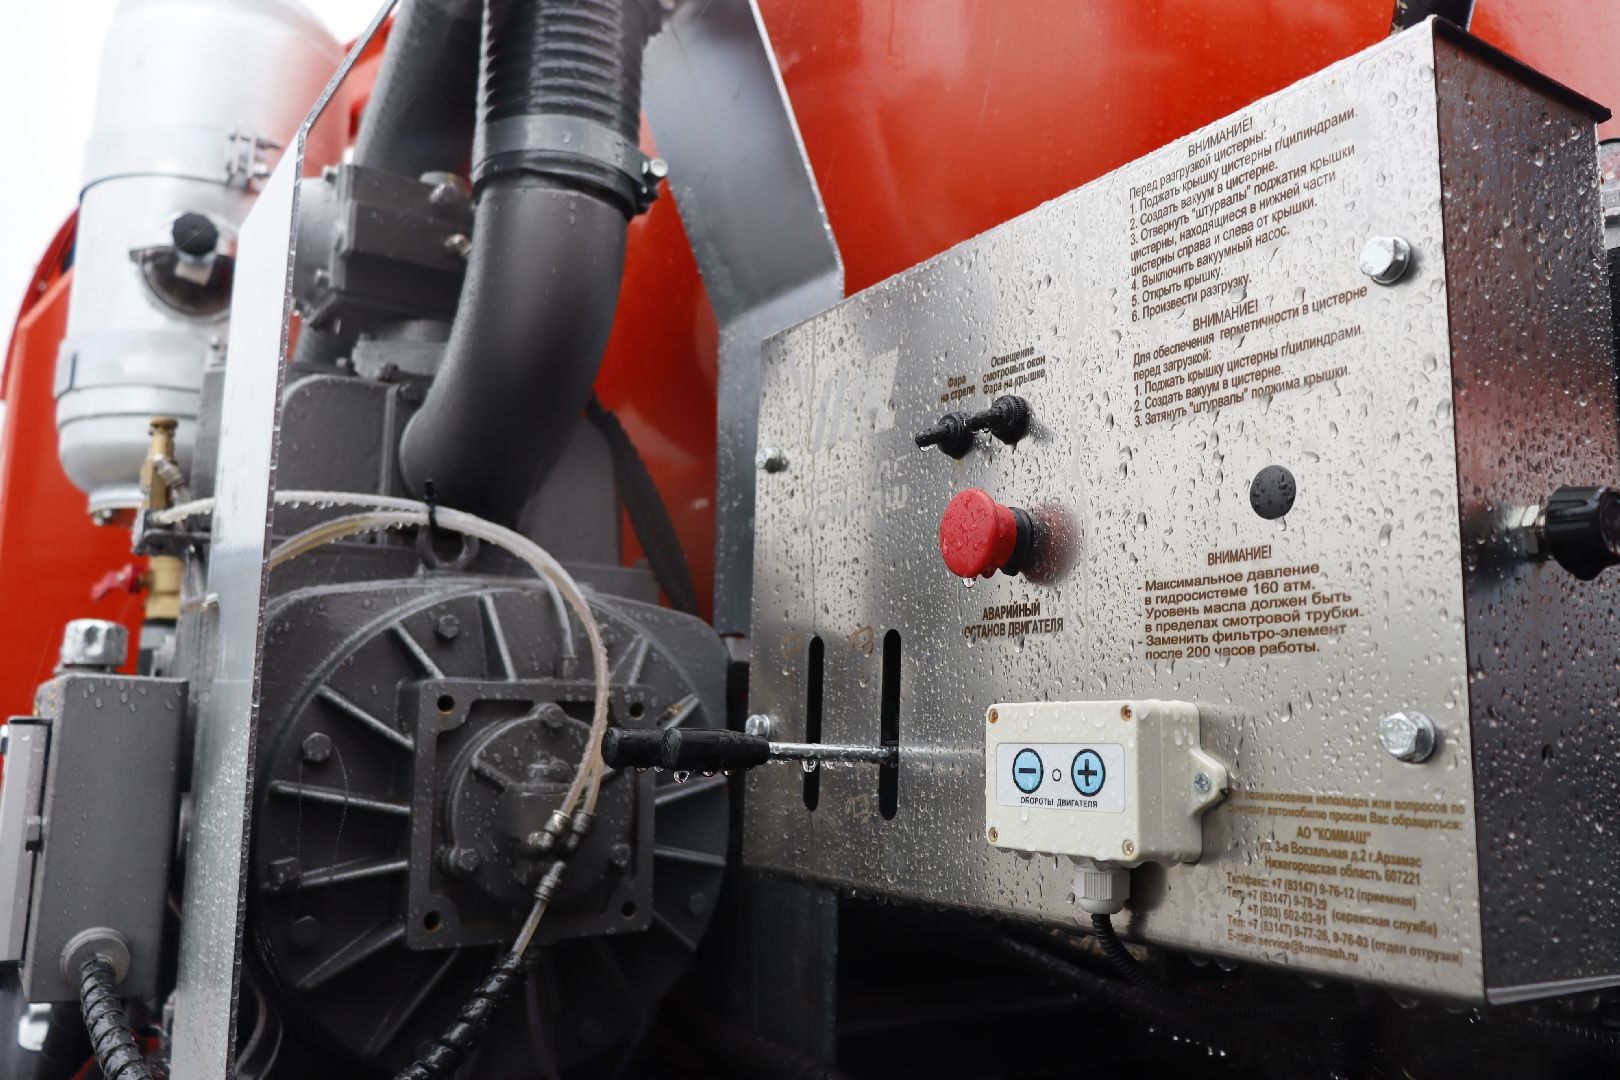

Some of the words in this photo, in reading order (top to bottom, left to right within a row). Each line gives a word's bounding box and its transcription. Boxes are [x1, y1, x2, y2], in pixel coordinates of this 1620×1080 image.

[1188, 116, 1253, 158] ВНИМАНИЕ!
[1129, 179, 1158, 200] Перед
[1160, 153, 1211, 189] разгрузкой
[1214, 130, 1267, 163] цистерны:
[1130, 202, 1138, 215] 1.
[1140, 185, 1180, 210] Поджать
[1182, 168, 1219, 193] крышку
[1221, 143, 1272, 176] цистерны
[1274, 107, 1358, 152] г/цилиндрами.
[1130, 218, 1138, 230] 2.
[1140, 203, 1179, 225] Создать
[1181, 187, 1215, 210] вакуум
[1217, 183, 1224, 194] в
[1226, 160, 1279, 190] цистерне.
[1130, 233, 1138, 246] 3.
[1140, 215, 1190, 241] Отвернуть
[1192, 186, 1250, 219] "штурвалы"
[1254, 164, 1307, 195] поджатия
[1310, 144, 1355, 175] крышки
[1131, 236, 1177, 261] цистерны,
[1180, 206, 1247, 241] находящиеся
[1250, 202, 1256, 214] в
[1259, 182, 1300, 211] нижней
[1303, 170, 1336, 193] части
[1131, 251, 1175, 276] цистерны
[1177, 237, 1211, 258] справа
[1214, 234, 1220, 245] и
[1222, 221, 1254, 242] слева
[1256, 216, 1268, 229] от
[1271, 197, 1317, 225] крышки.
[1131, 278, 1139, 291] 4.
[1142, 261, 1194, 287] Выключить
[1197, 233, 1252, 267] вакуумный
[1255, 224, 1290, 249] насос.
[1131, 294, 1139, 307] 5.
[1142, 282, 1181, 303] Открыть
[1184, 266, 1224, 290] крышку.
[1131, 309, 1140, 322] 6.
[1142, 292, 1198, 320] Произвести
[1200, 273, 1252, 302] разгрузку.
[1133, 351, 1151, 368] Для
[1153, 332, 1215, 360] обеспечения
[1220, 306, 1299, 340] герметичности
[1302, 303, 1309, 315] в
[1312, 286, 1368, 313] цистерне
[1192, 298, 1259, 332] ВНИМАНИЕ!
[982, 363, 1025, 383] смотровых
[1026, 355, 1046, 369] окон
[991, 345, 1035, 368] Освещение
[1133, 364, 1161, 381] перед
[1163, 348, 1212, 373] загрузкой:
[1134, 383, 1142, 397] 1.
[1144, 374, 1185, 395] Поджать
[1187, 362, 1224, 385] крышку
[1227, 348, 1278, 372] цистерны
[1281, 324, 1364, 357] г/цилиндрами.
[947, 375, 967, 388] Фара
[950, 383, 976, 401] стреле
[983, 381, 1002, 395] Фара
[1004, 378, 1013, 389] на
[1014, 368, 1046, 388] крышке
[1134, 399, 1142, 413] 2.
[1144, 392, 1184, 410] Создать
[1185, 381, 1219, 399] вакуум
[1222, 378, 1229, 390] в
[1231, 364, 1284, 388] цистерне.
[1134, 414, 1142, 428] 3.
[1144, 406, 1187, 426] Затянуть
[1189, 387, 1248, 414] "штурвалы"
[1251, 377, 1300, 399] поджима
[1303, 365, 1351, 389] крышки.
[1207, 544, 1272, 567] ВНИМАНИЕ!
[1145, 573, 1243, 592] Максимальное
[1247, 562, 1320, 582] давление
[1144, 594, 1151, 605] в
[1155, 585, 1248, 607] гидросистеме
[1253, 581, 1279, 595] 160
[1283, 580, 1316, 593] атм.
[1145, 605, 1200, 621] Уровень
[1203, 601, 1246, 615] масла
[1250, 596, 1307, 612] должен
[1312, 591, 1352, 604] быть
[982, 598, 1041, 621] АВАРИЙНЫЙ
[1144, 622, 1152, 633] в
[1156, 619, 1219, 634] пределах
[1222, 610, 1301, 628] смотровой
[1305, 606, 1364, 624] трубки.
[964, 622, 1006, 639] ОСТАНОВ
[1008, 617, 1064, 639] ДВИГАТЕЛЯ
[1146, 631, 1209, 647] Заменить
[1212, 623, 1347, 645] фильтро-элемент
[1145, 649, 1183, 661] после
[1186, 646, 1211, 658] 200
[1214, 644, 1255, 657] часов
[1260, 641, 1320, 658] работы.
[1020, 796, 1054, 806] ОБОРОТЫ
[1056, 798, 1098, 809] ДВИГАТЕЛЯ
[1267, 806, 1327, 820] автомобилю
[1329, 811, 1367, 823] просим
[1370, 812, 1389, 825] Вас
[1371, 800, 1391, 810] или
[1394, 800, 1448, 814] вопросов
[1450, 804, 1465, 815] по
[1275, 840, 1289, 853] 3-я
[1290, 841, 1348, 859] Вокзальная
[1296, 826, 1312, 839] АО
[1313, 827, 1371, 844] "КОММАШ"
[1264, 855, 1337, 876] Нижегородская
[1340, 863, 1382, 881] область
[1384, 869, 1420, 886] 607221
[1247, 889, 1258, 901] +7
[1260, 891, 1292, 908] (83147)
[1271, 878, 1282, 889] +7
[1284, 879, 1318, 897] (83147)
[1319, 884, 1354, 899] 9-76-12
[1356, 888, 1417, 911] (приемная)
[1247, 904, 1258, 915] +7
[1260, 905, 1281, 922] (903)
[1332, 908, 1390, 928] (сервисная
[1392, 919, 1438, 939] служба)
[1247, 919, 1258, 930] +7
[1260, 920, 1292, 938] (83147)
[1371, 938, 1407, 956] (отдел
[1258, 937, 1359, 962] service@kommash.ru
